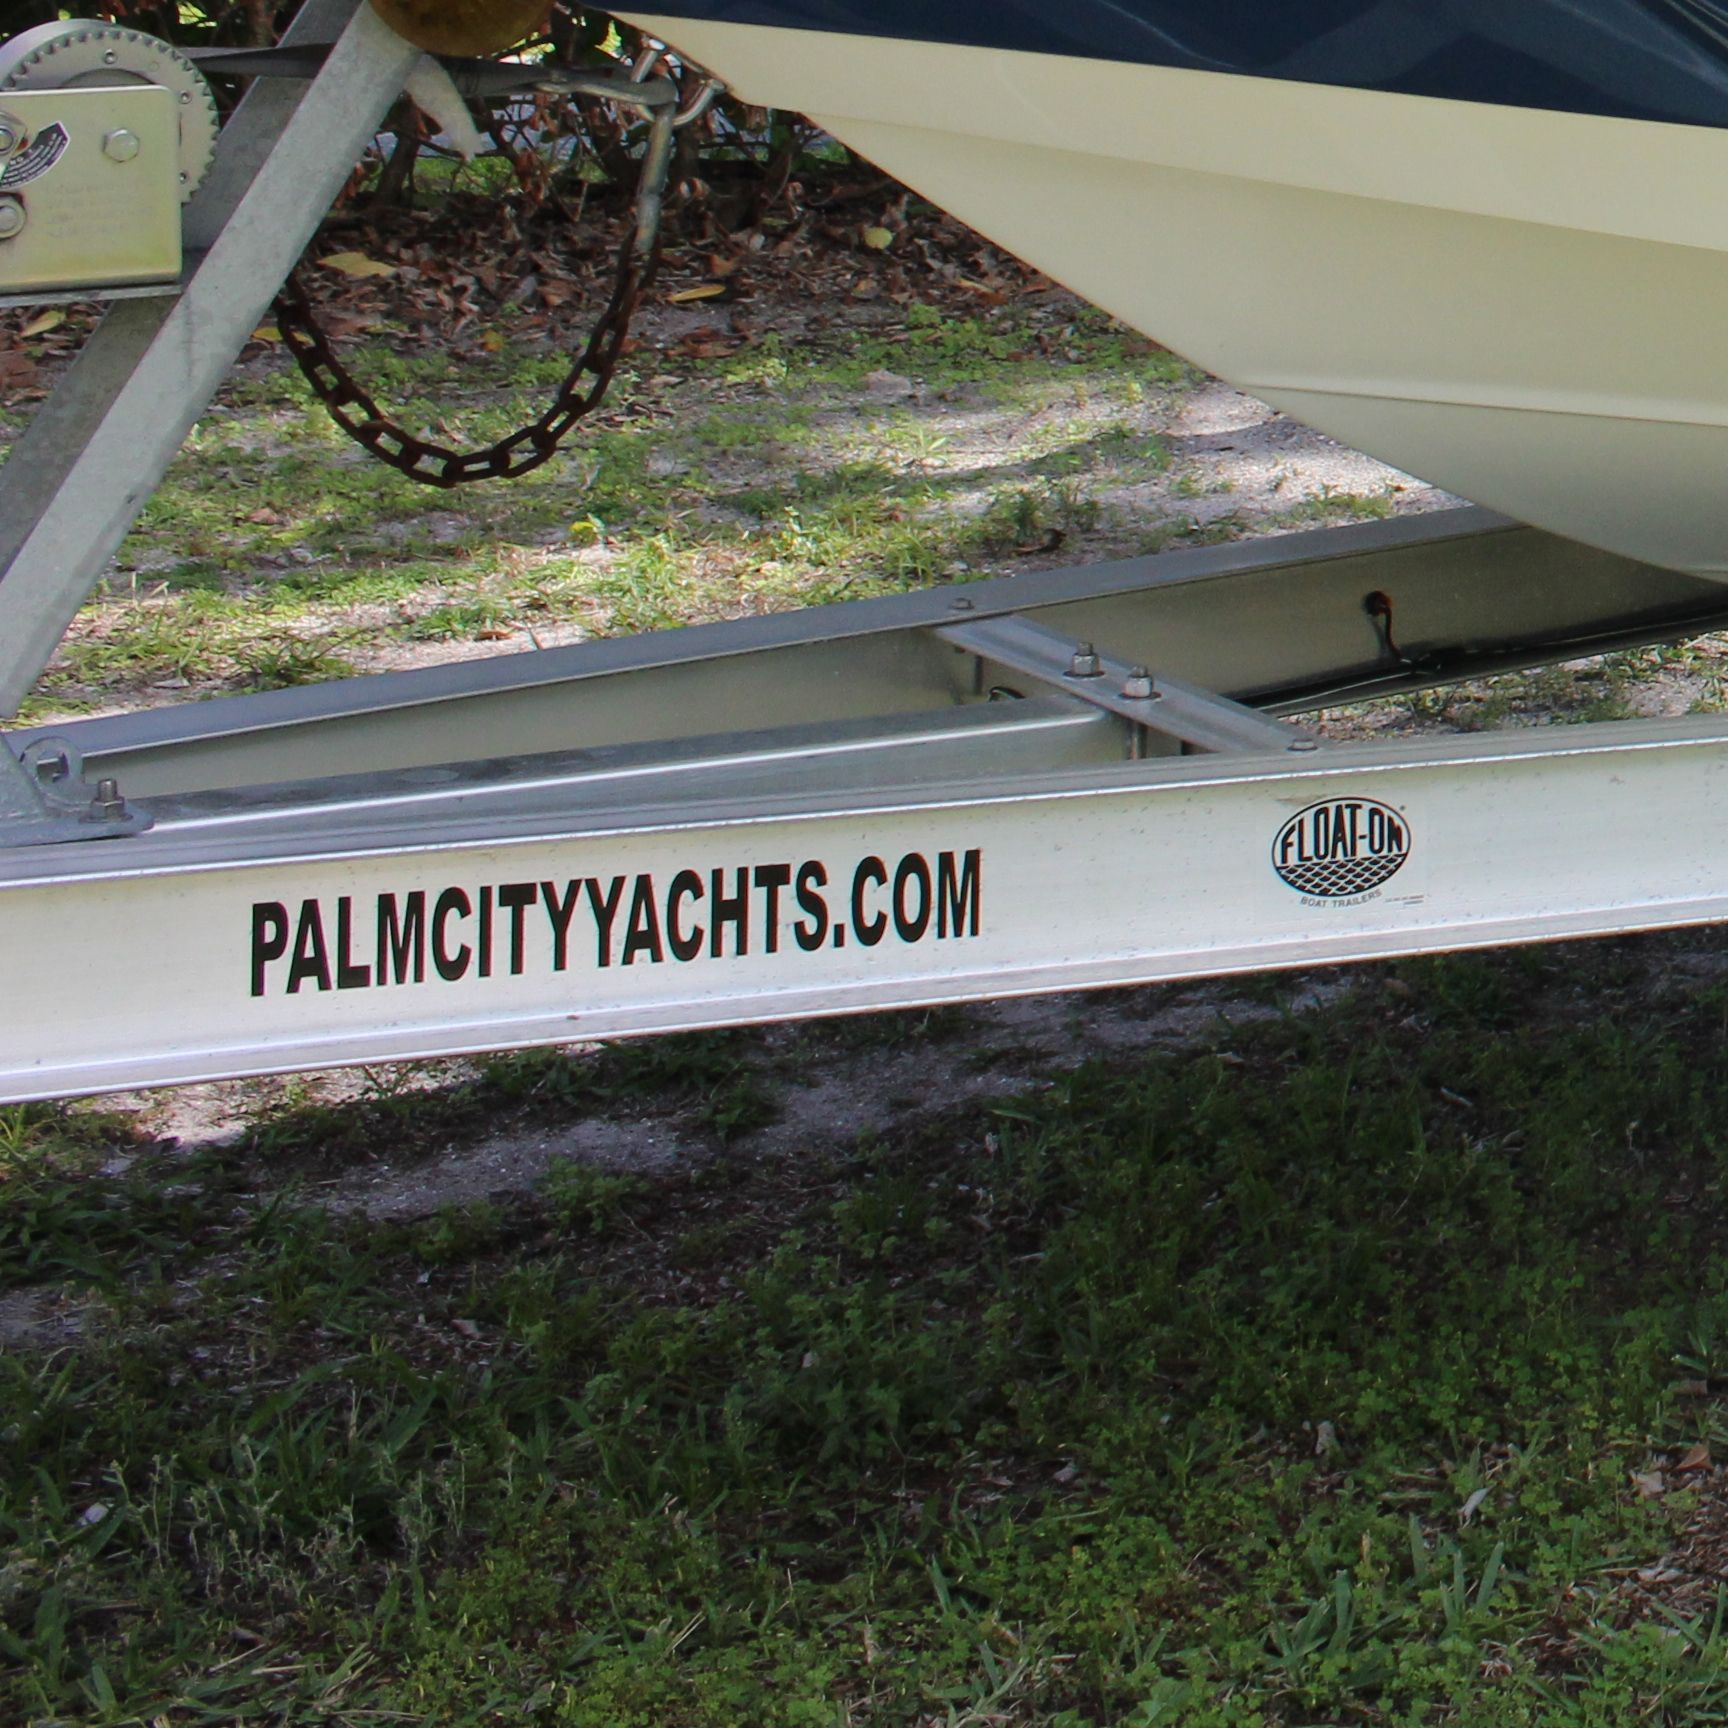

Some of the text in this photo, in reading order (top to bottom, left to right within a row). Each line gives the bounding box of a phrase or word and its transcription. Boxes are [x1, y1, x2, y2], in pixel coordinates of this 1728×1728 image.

[1281, 803, 1403, 864] FLOAT-ON
[251, 848, 983, 998] PALMCITYYACHTS.COM
[1300, 895, 1328, 909] BOAT
[1332, 889, 1383, 909] TRAILERS
